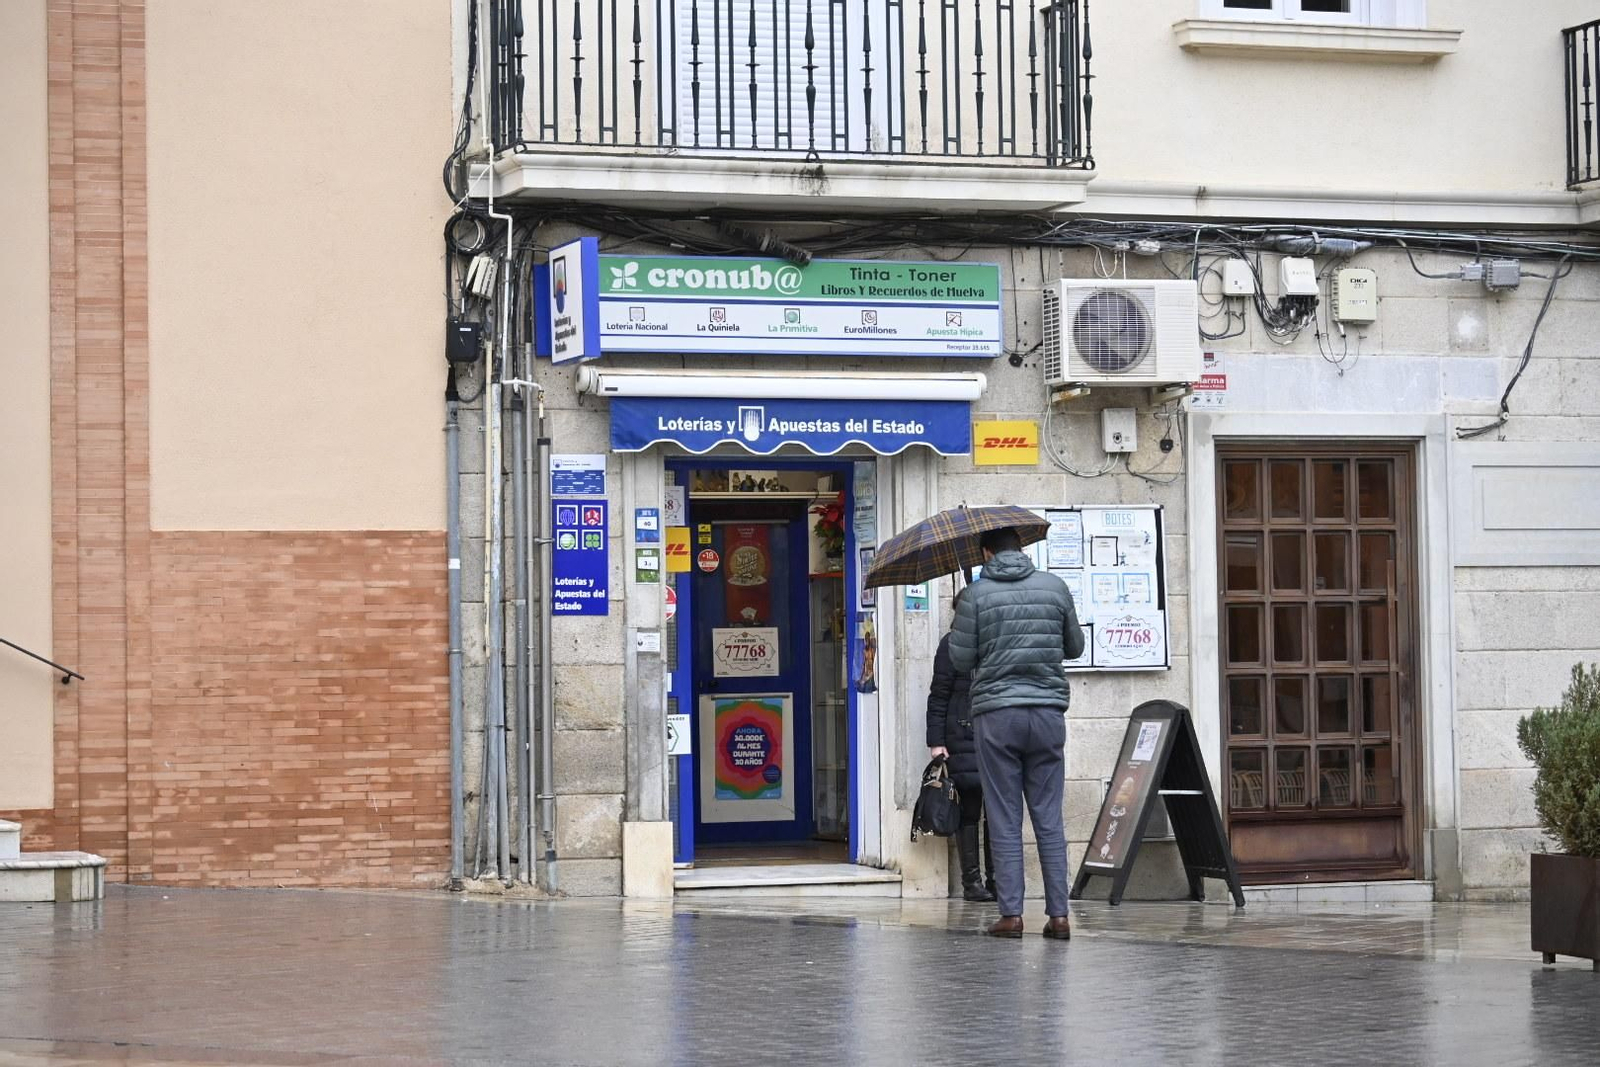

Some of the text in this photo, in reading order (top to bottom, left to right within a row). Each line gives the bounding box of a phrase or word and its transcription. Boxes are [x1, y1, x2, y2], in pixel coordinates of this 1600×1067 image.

[648, 264, 803, 295] cronub@
[850, 267, 890, 281] Tinta
[909, 268, 957, 282] Toner
[821, 284, 985, 298] Libros Y Recuerdos de Huelva
[635, 322, 668, 331] Nacional
[697, 323, 740, 332] La Quiniela
[767, 324, 818, 333] La Primitiva
[844, 325, 898, 335] EuroMillones
[926, 327, 958, 337] Apuesta
[658, 416, 925, 435] Loterías y Apuestas del Estado
[983, 437, 1029, 448] DHL
[1105, 513, 1132, 525] BOTES
[554, 576, 595, 588] Loterías y
[554, 589, 606, 600] Apuestas del
[554, 601, 582, 611] Estado
[1105, 628, 1152, 645] 77768
[725, 643, 766, 658] 77768
[732, 750, 766, 758] DURANTE
